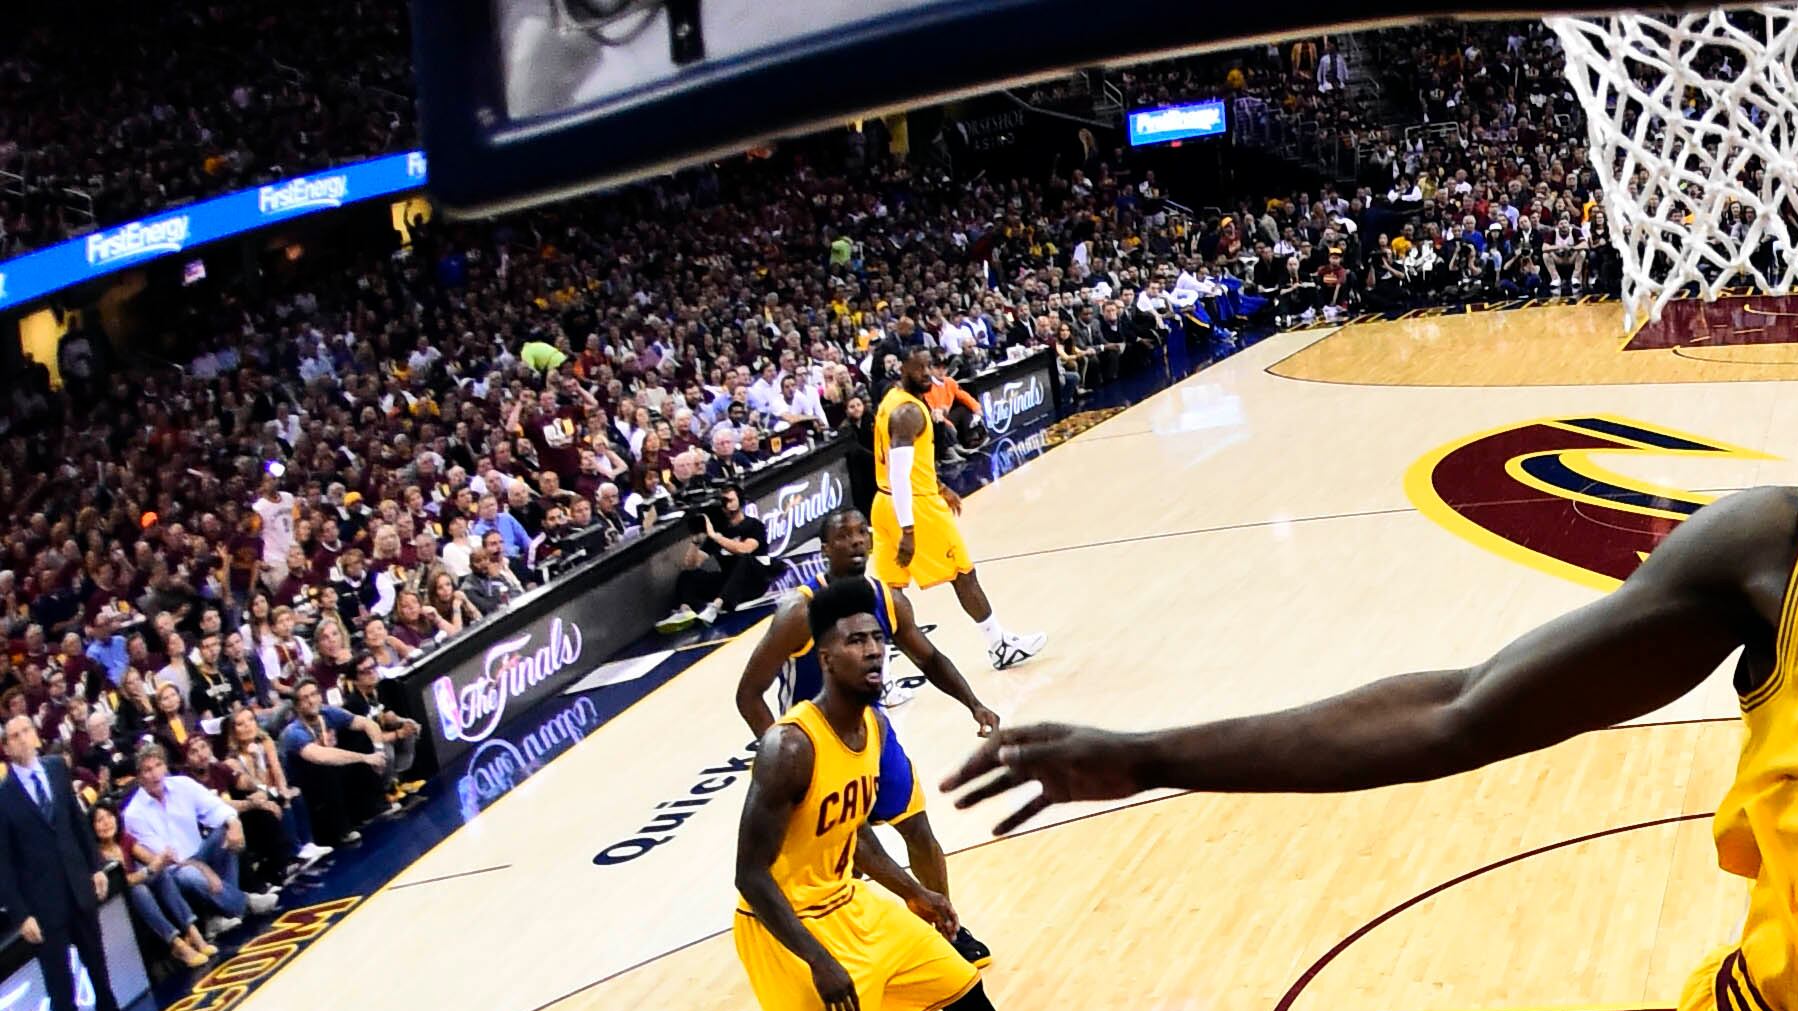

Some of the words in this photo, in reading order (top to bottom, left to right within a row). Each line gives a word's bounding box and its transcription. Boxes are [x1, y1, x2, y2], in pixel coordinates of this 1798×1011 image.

[258, 174, 349, 214] FirstEnergy
[86, 215, 191, 265] FirstEnergy
[992, 375, 1044, 434] Finals
[768, 471, 842, 557] Finals
[460, 676, 498, 729] The
[462, 618, 582, 742] Finals
[815, 775, 880, 837] CAV
